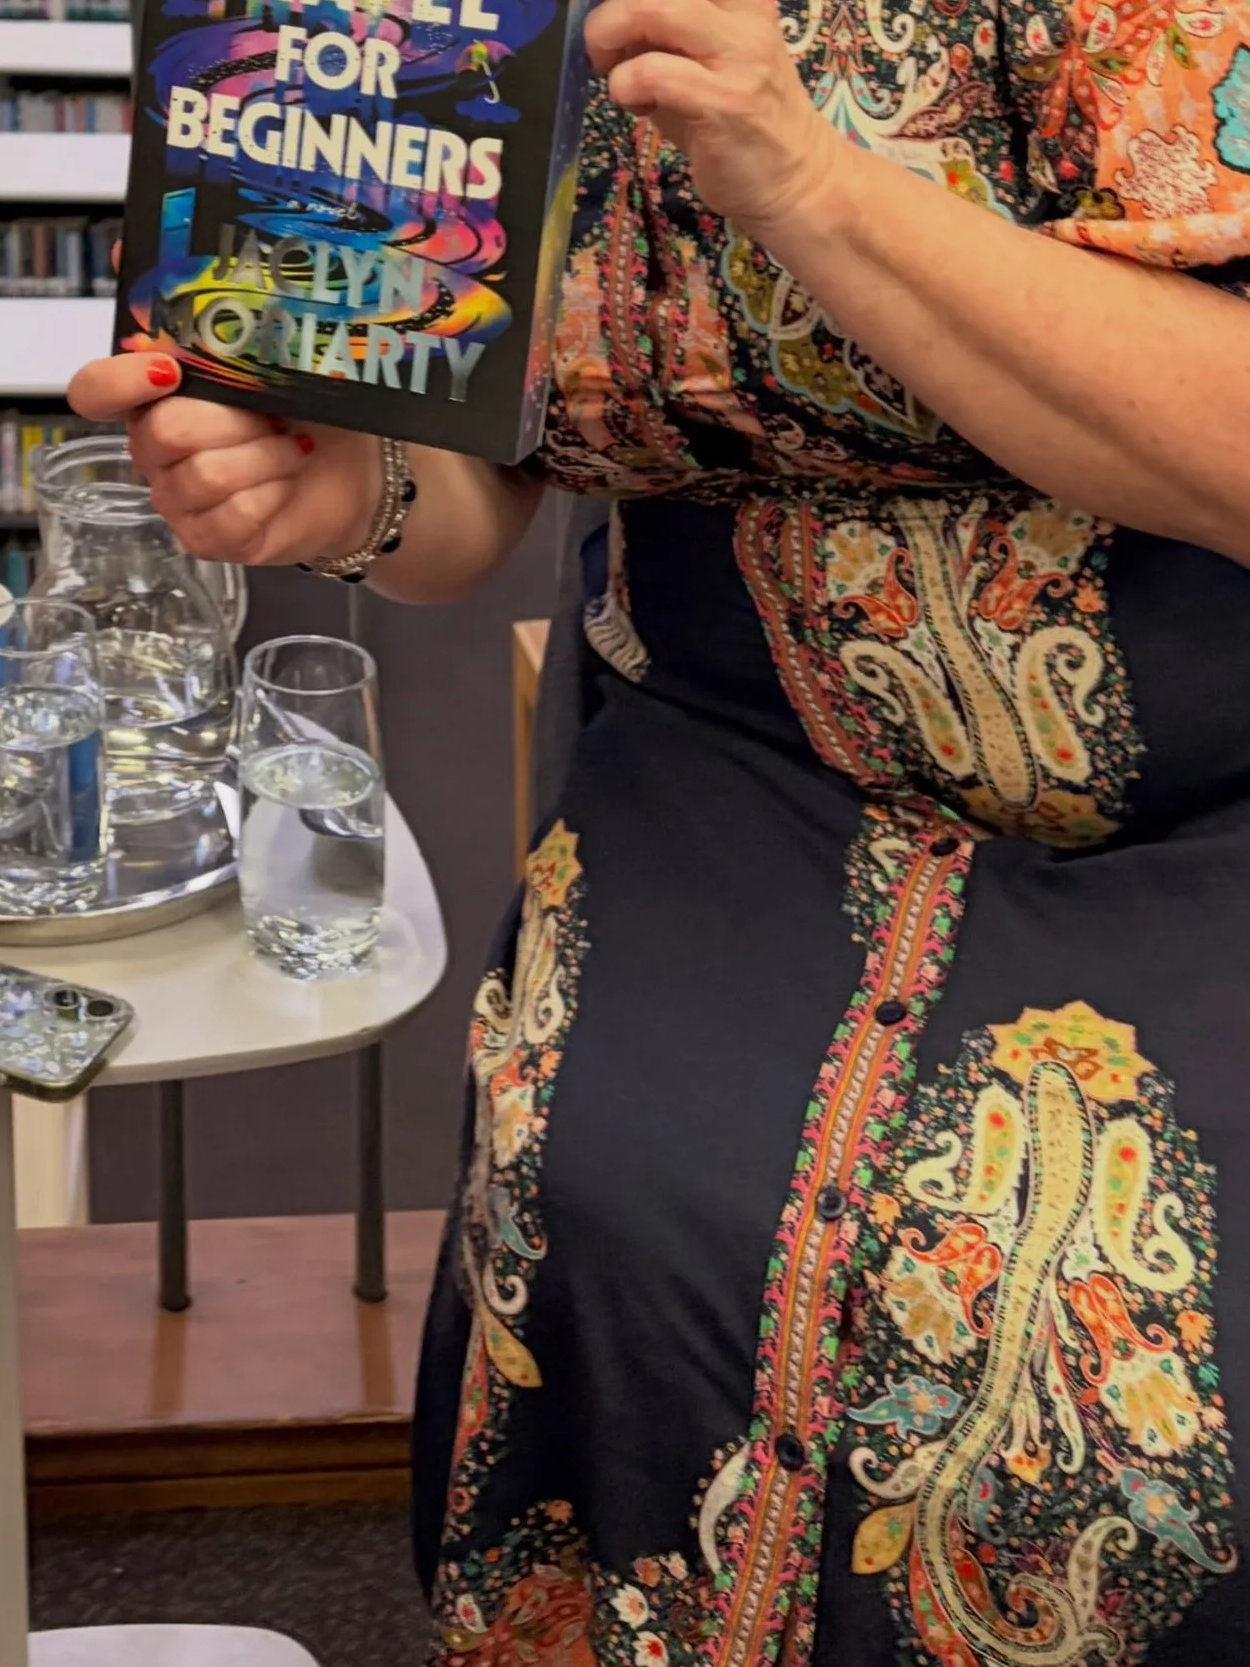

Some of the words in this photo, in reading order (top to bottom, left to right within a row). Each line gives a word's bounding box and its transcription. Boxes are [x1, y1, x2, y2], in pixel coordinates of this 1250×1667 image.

[275, 25, 401, 99] FOR
[166, 86, 504, 200] BEGINNERS
[305, 202, 358, 220] novel
[213, 224, 425, 314] JACLYN
[149, 285, 486, 403] MORIARTY
